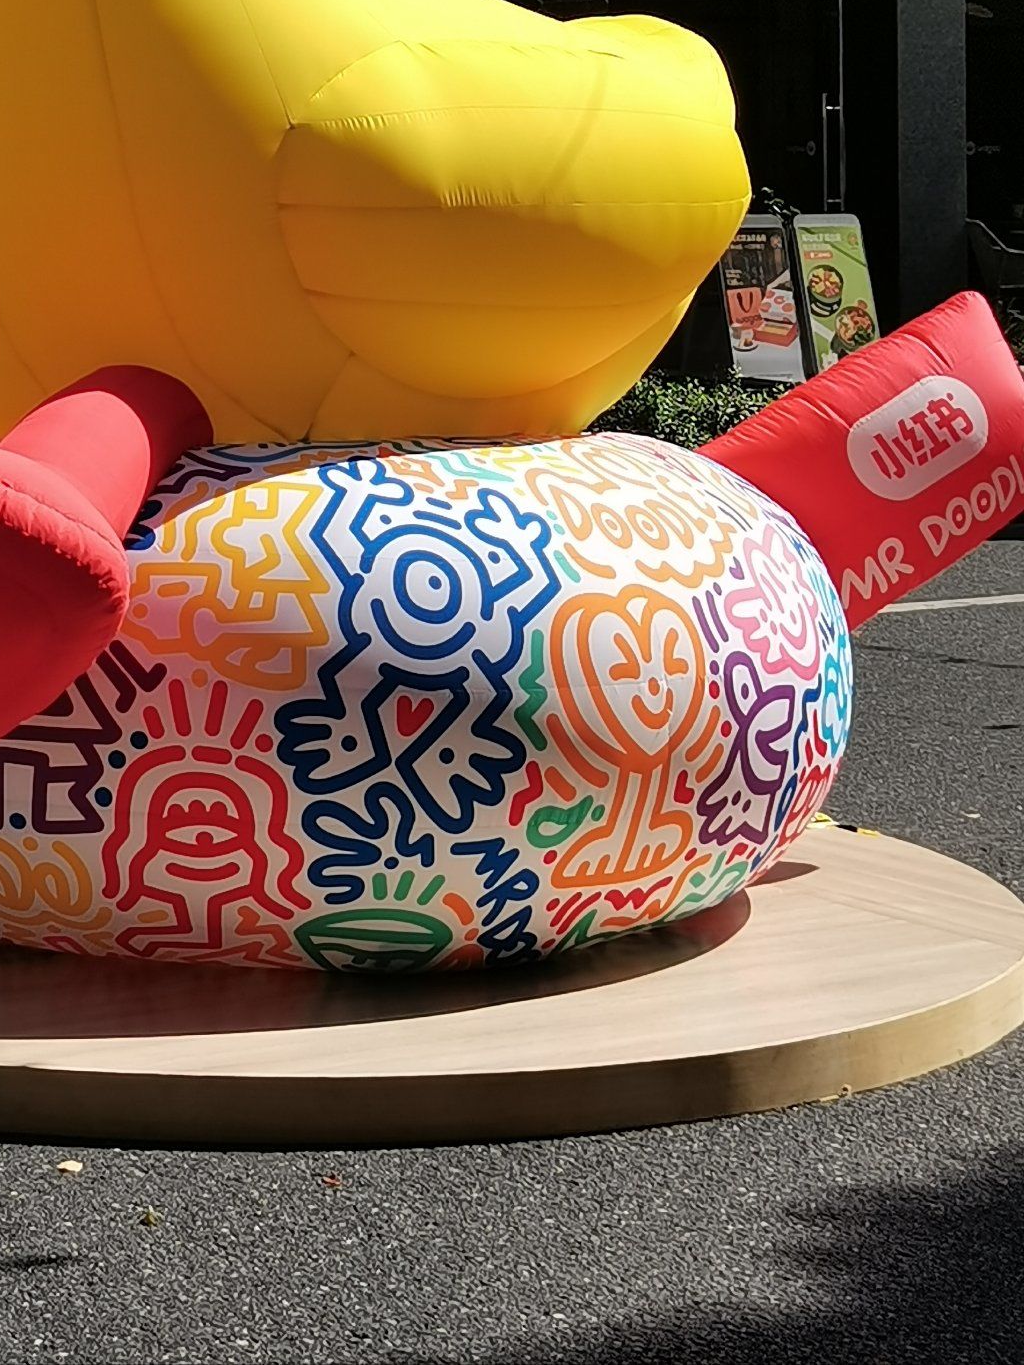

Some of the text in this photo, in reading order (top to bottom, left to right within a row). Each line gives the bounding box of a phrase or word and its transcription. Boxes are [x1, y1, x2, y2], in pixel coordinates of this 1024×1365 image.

[871, 392, 974, 480] 小红书
[841, 537, 915, 610] MR
